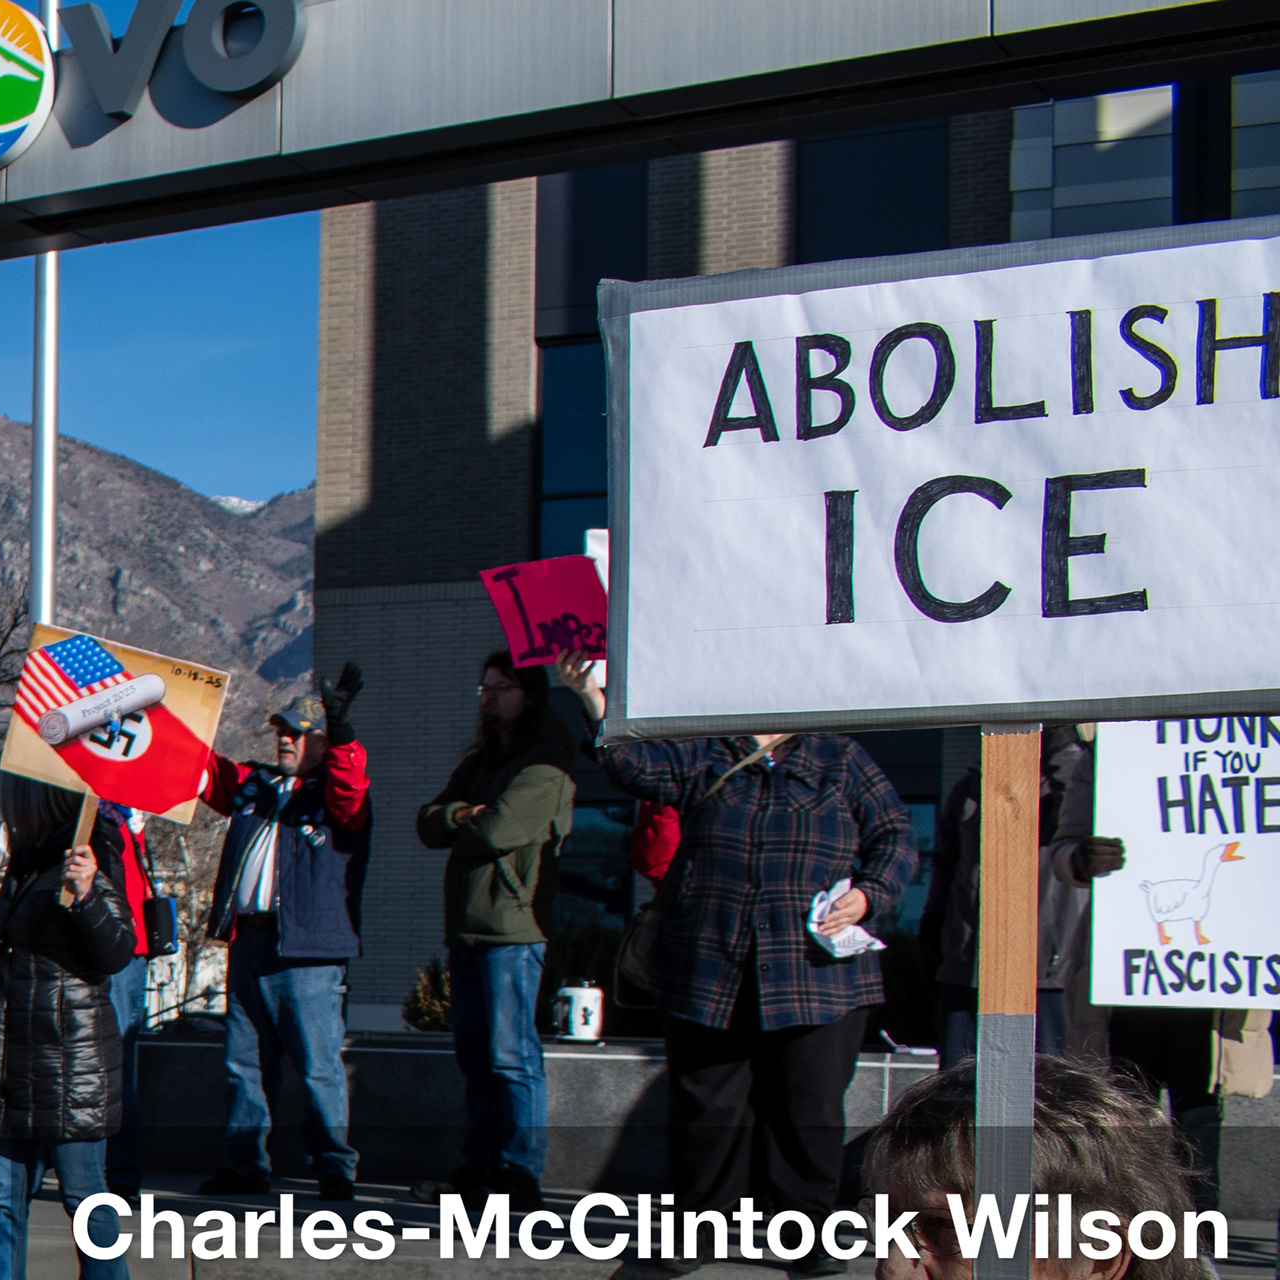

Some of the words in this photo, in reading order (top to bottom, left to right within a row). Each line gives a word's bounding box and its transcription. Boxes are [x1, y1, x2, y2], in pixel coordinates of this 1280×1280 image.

[702, 290, 1280, 447] ABOLISH
[824, 467, 1149, 625] ICE
[81, 697, 112, 719] Project
[112, 684, 137, 703] 2025
[1184, 751, 1207, 772] IF
[1214, 750, 1261, 774] YOU
[1157, 774, 1280, 834] HATE
[1122, 949, 1280, 997] FASCISTS
